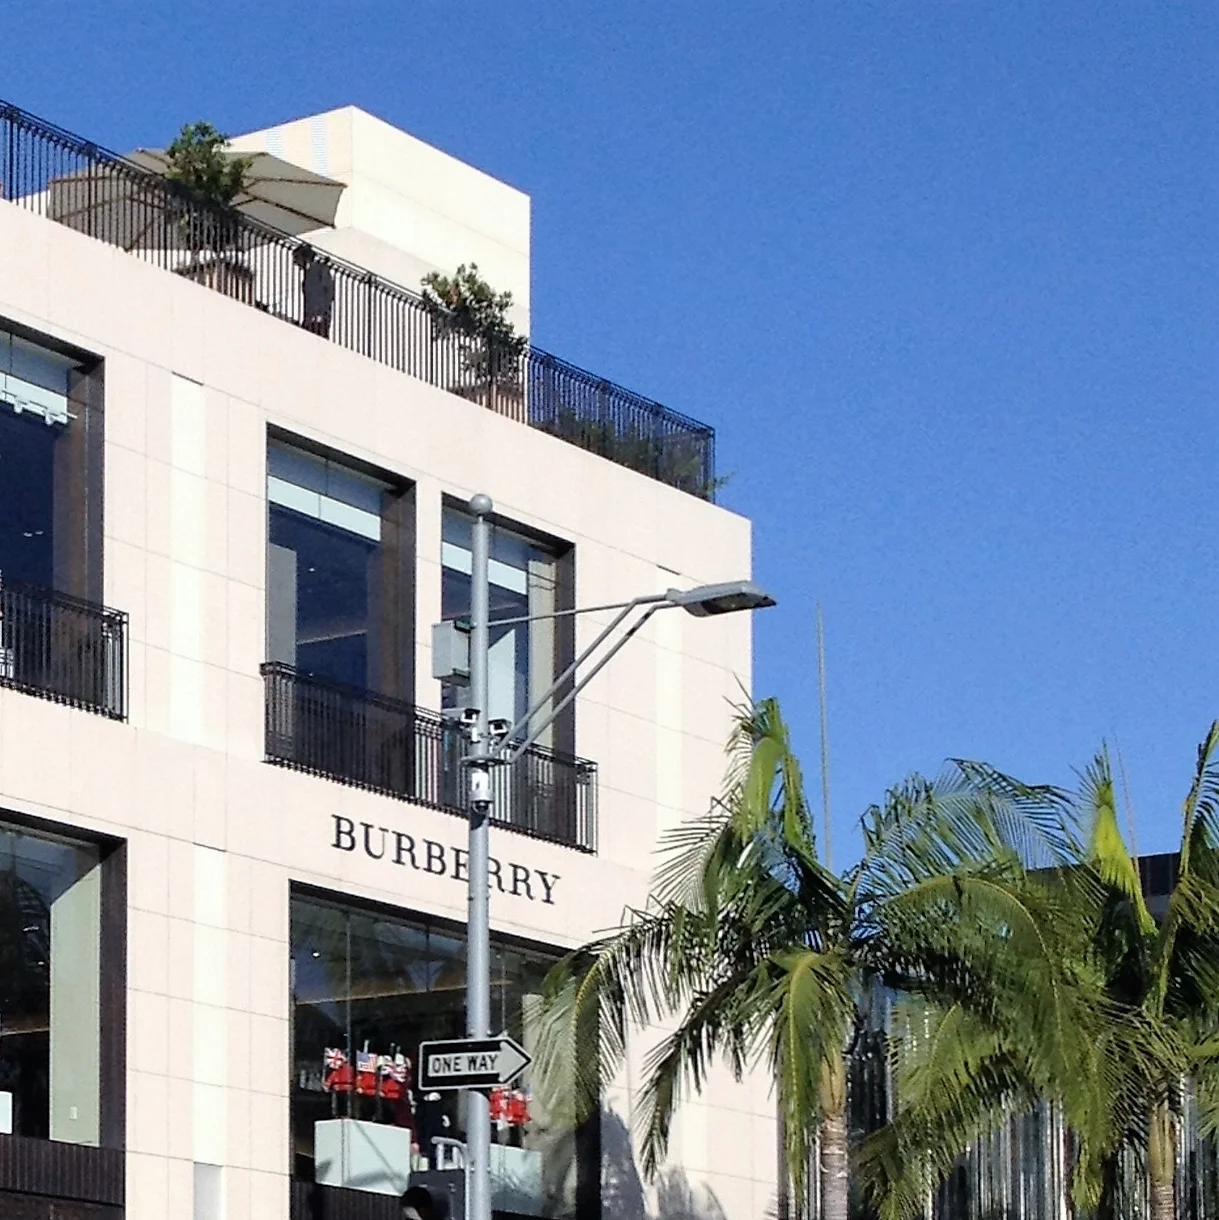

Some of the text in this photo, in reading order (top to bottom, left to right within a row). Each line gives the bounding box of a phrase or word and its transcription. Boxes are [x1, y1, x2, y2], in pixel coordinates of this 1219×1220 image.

[331, 814, 561, 904] BURBERRY
[432, 1054, 498, 1073] ONE WAY
